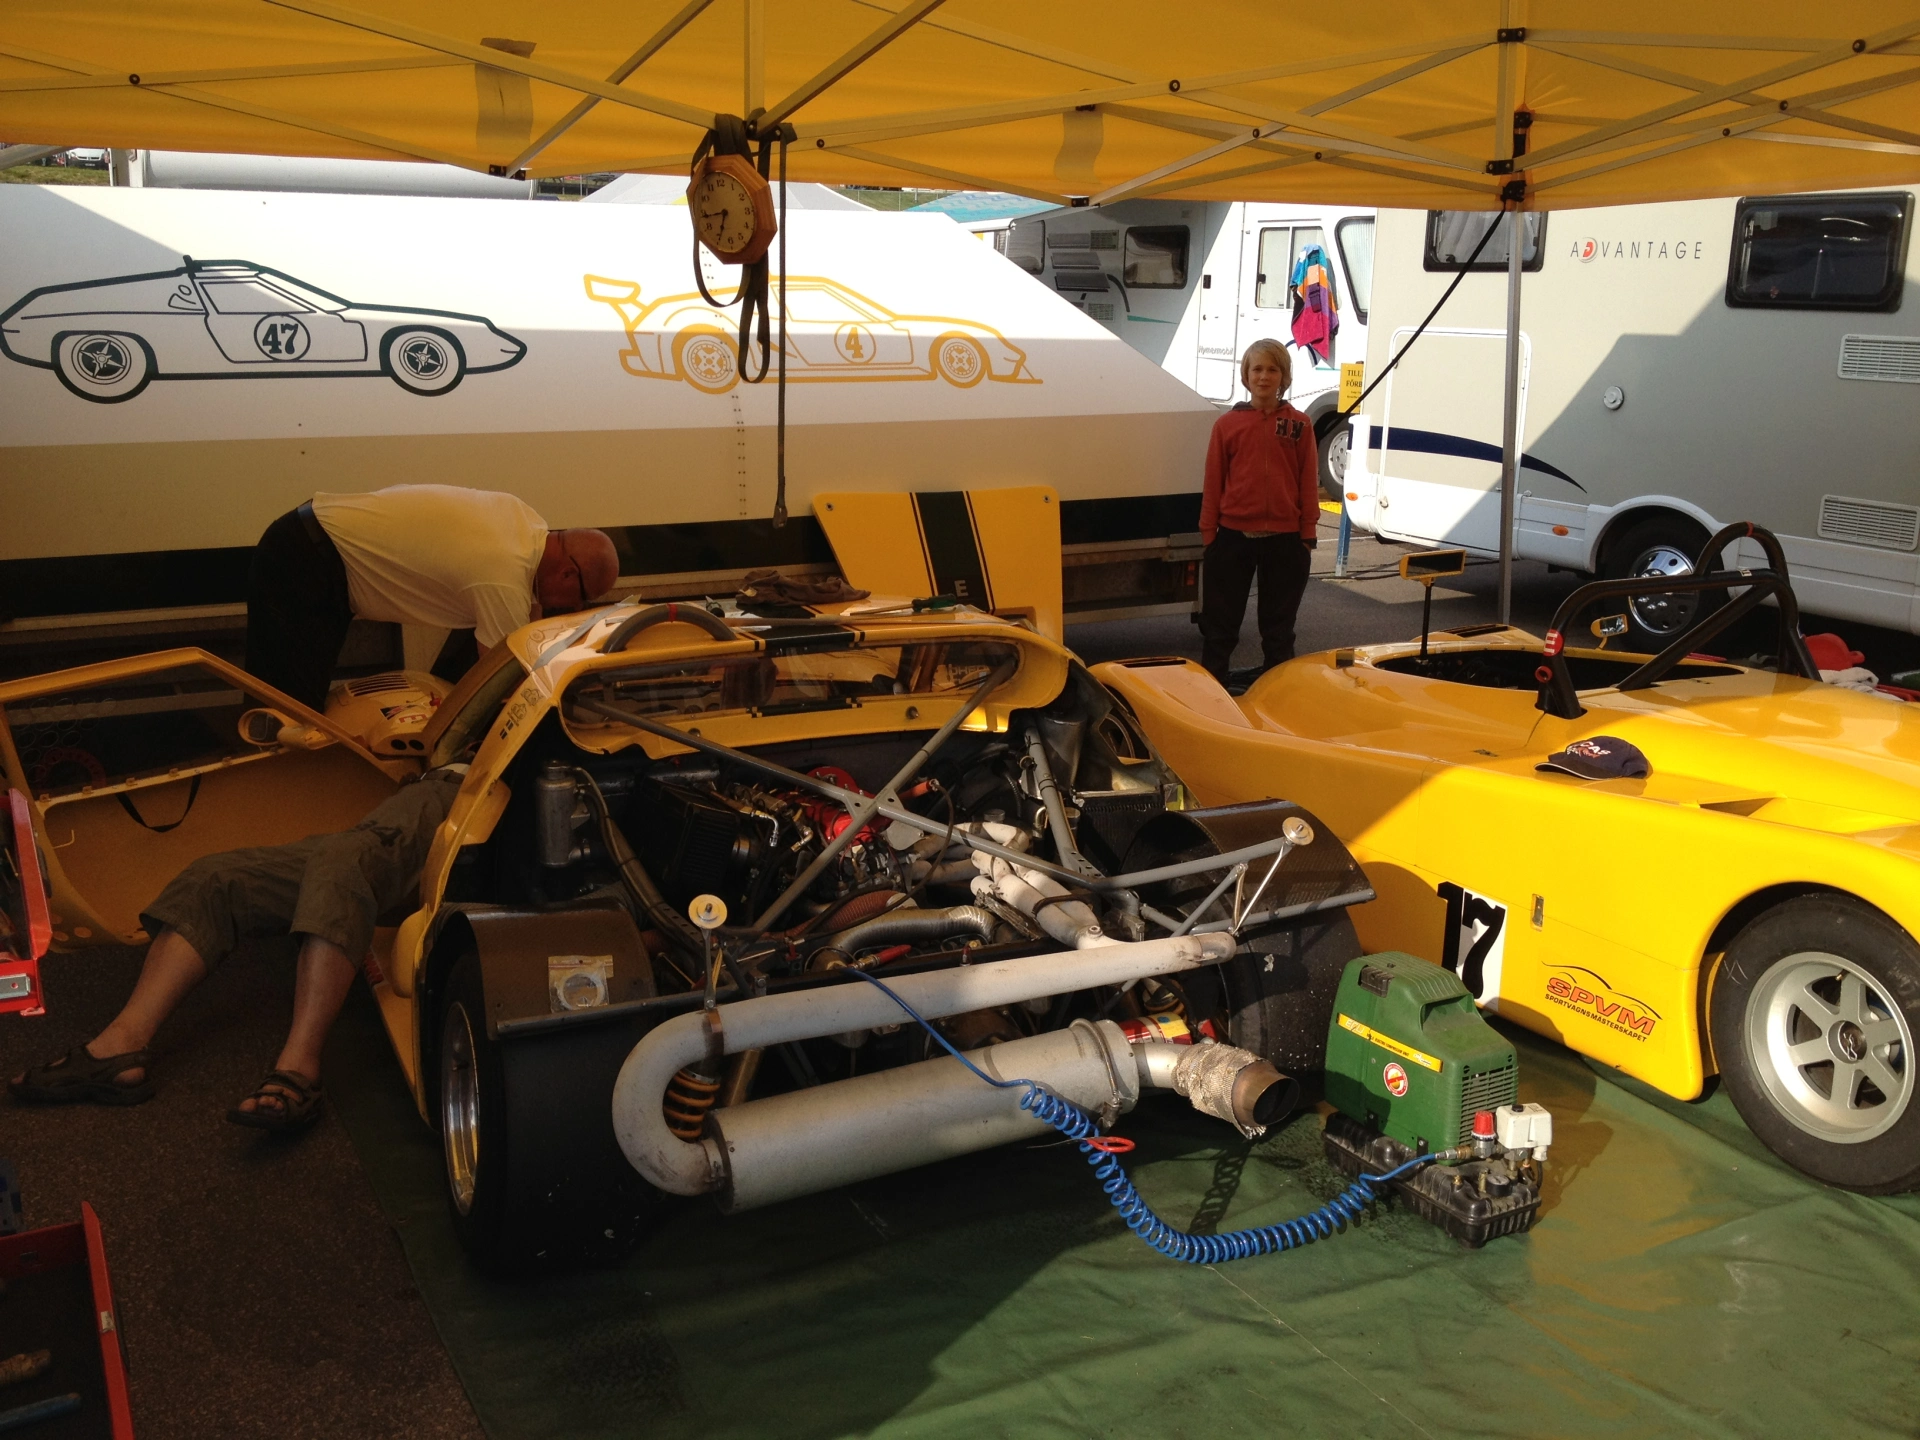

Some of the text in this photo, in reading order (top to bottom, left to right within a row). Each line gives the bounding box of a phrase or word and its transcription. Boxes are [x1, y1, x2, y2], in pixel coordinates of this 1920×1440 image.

[715, 179, 725, 187] 12
[707, 184, 714, 192] 11
[738, 193, 745, 201] 2
[744, 207, 751, 215] 3
[728, 236, 734, 244] 6
[738, 232, 744, 240] 5
[1570, 238, 1702, 262] ADVANTAGE
[262, 323, 299, 354] 47
[845, 326, 863, 358] 4
[1437, 881, 1506, 999] 17
[1547, 977, 1656, 1036] SPVM
